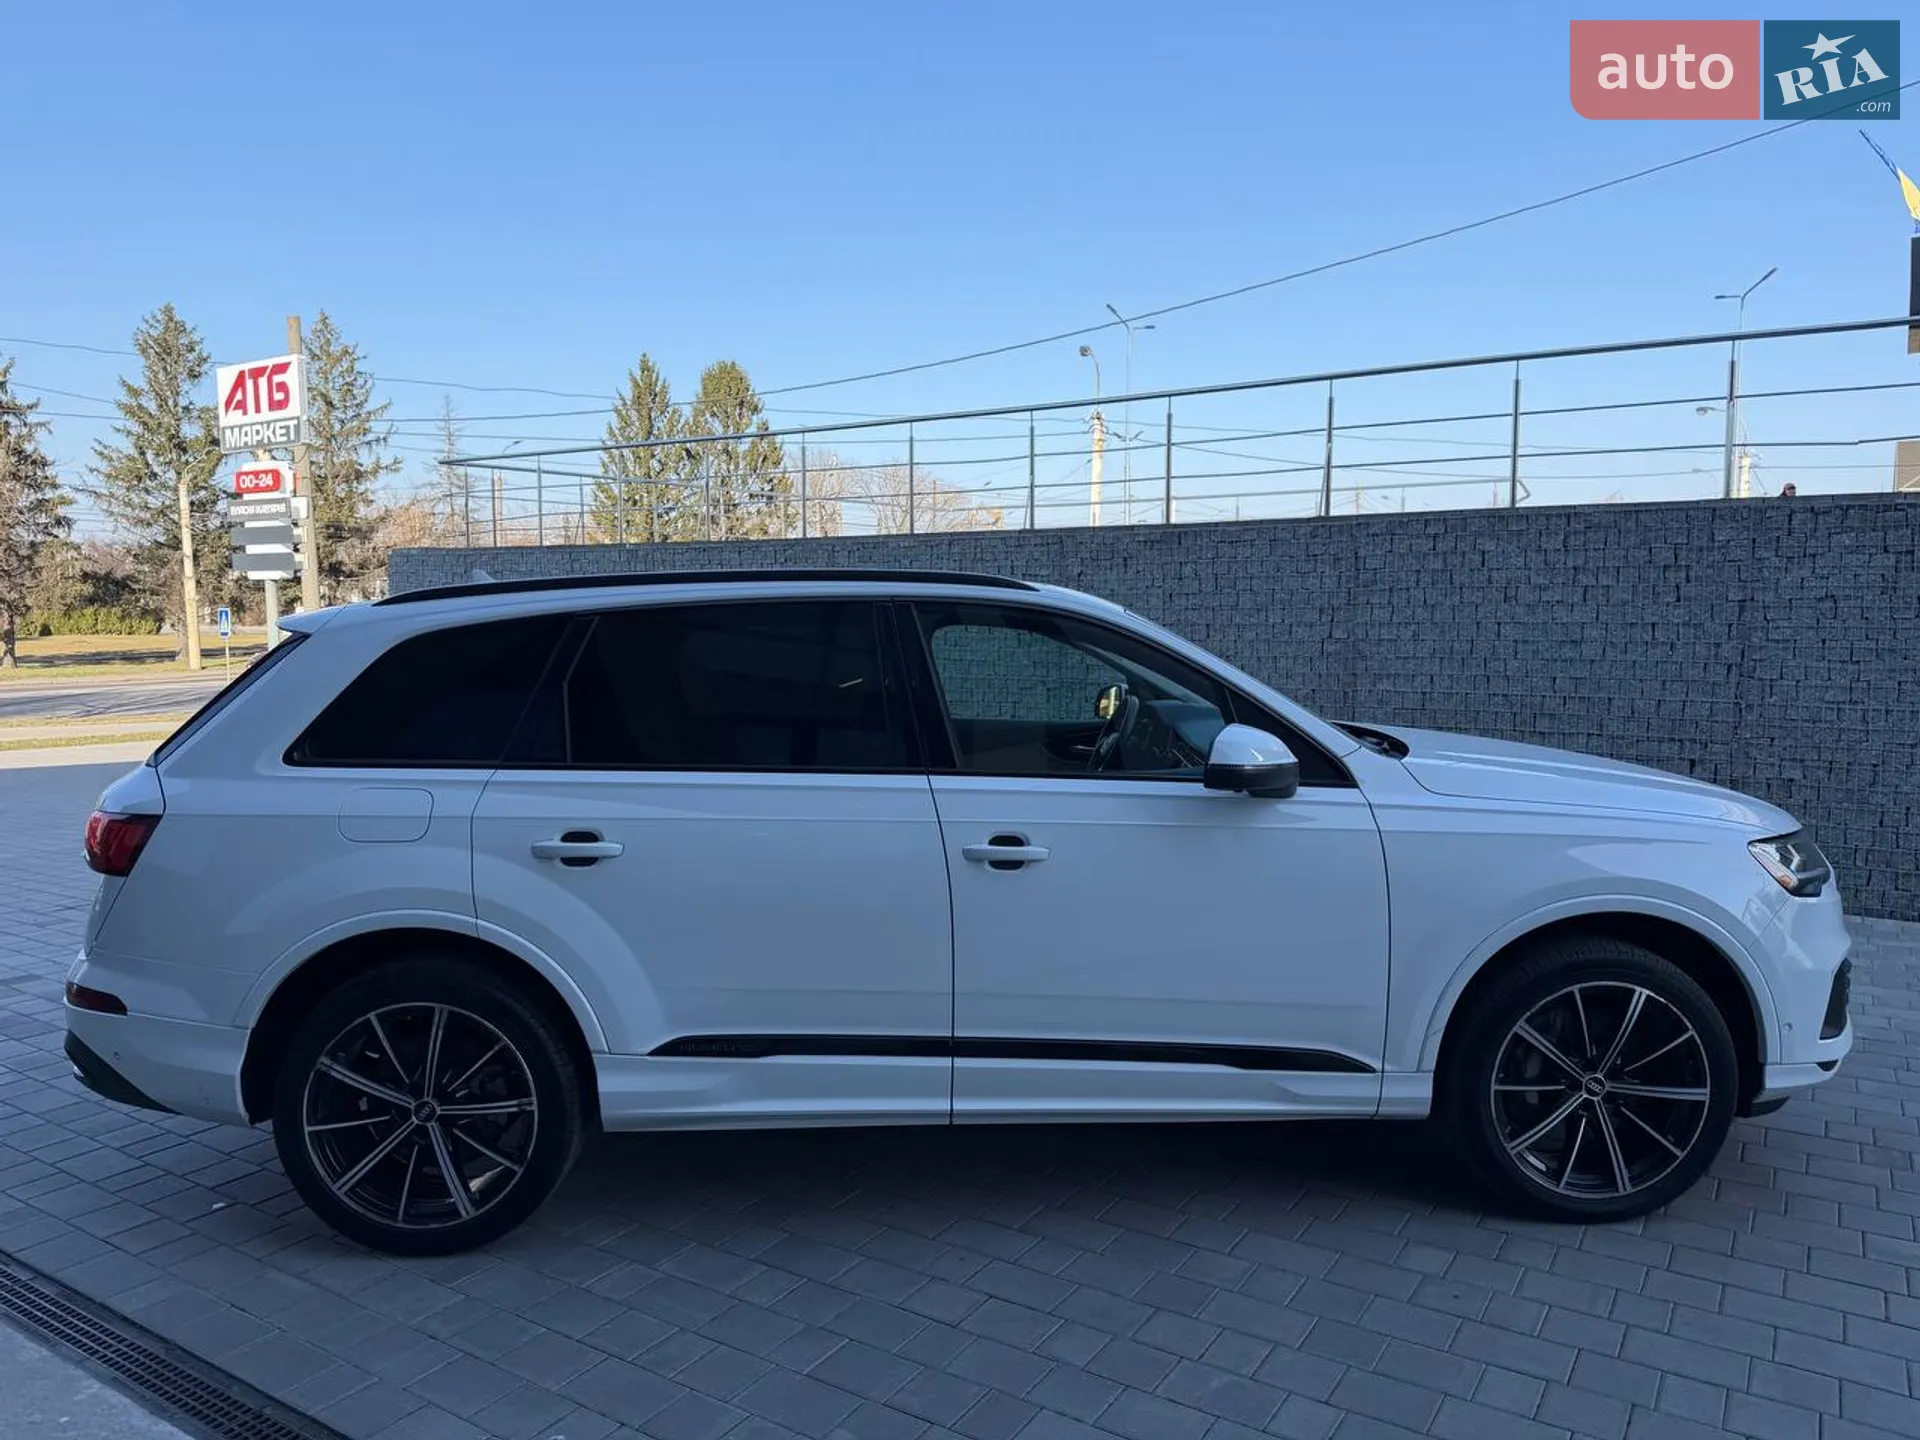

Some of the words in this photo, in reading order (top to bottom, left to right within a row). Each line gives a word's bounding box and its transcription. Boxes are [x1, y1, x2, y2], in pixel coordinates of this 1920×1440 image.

[224, 361, 293, 417] АТБ
[224, 419, 298, 450] МАРКЕТ
[239, 472, 274, 489] 00-24
